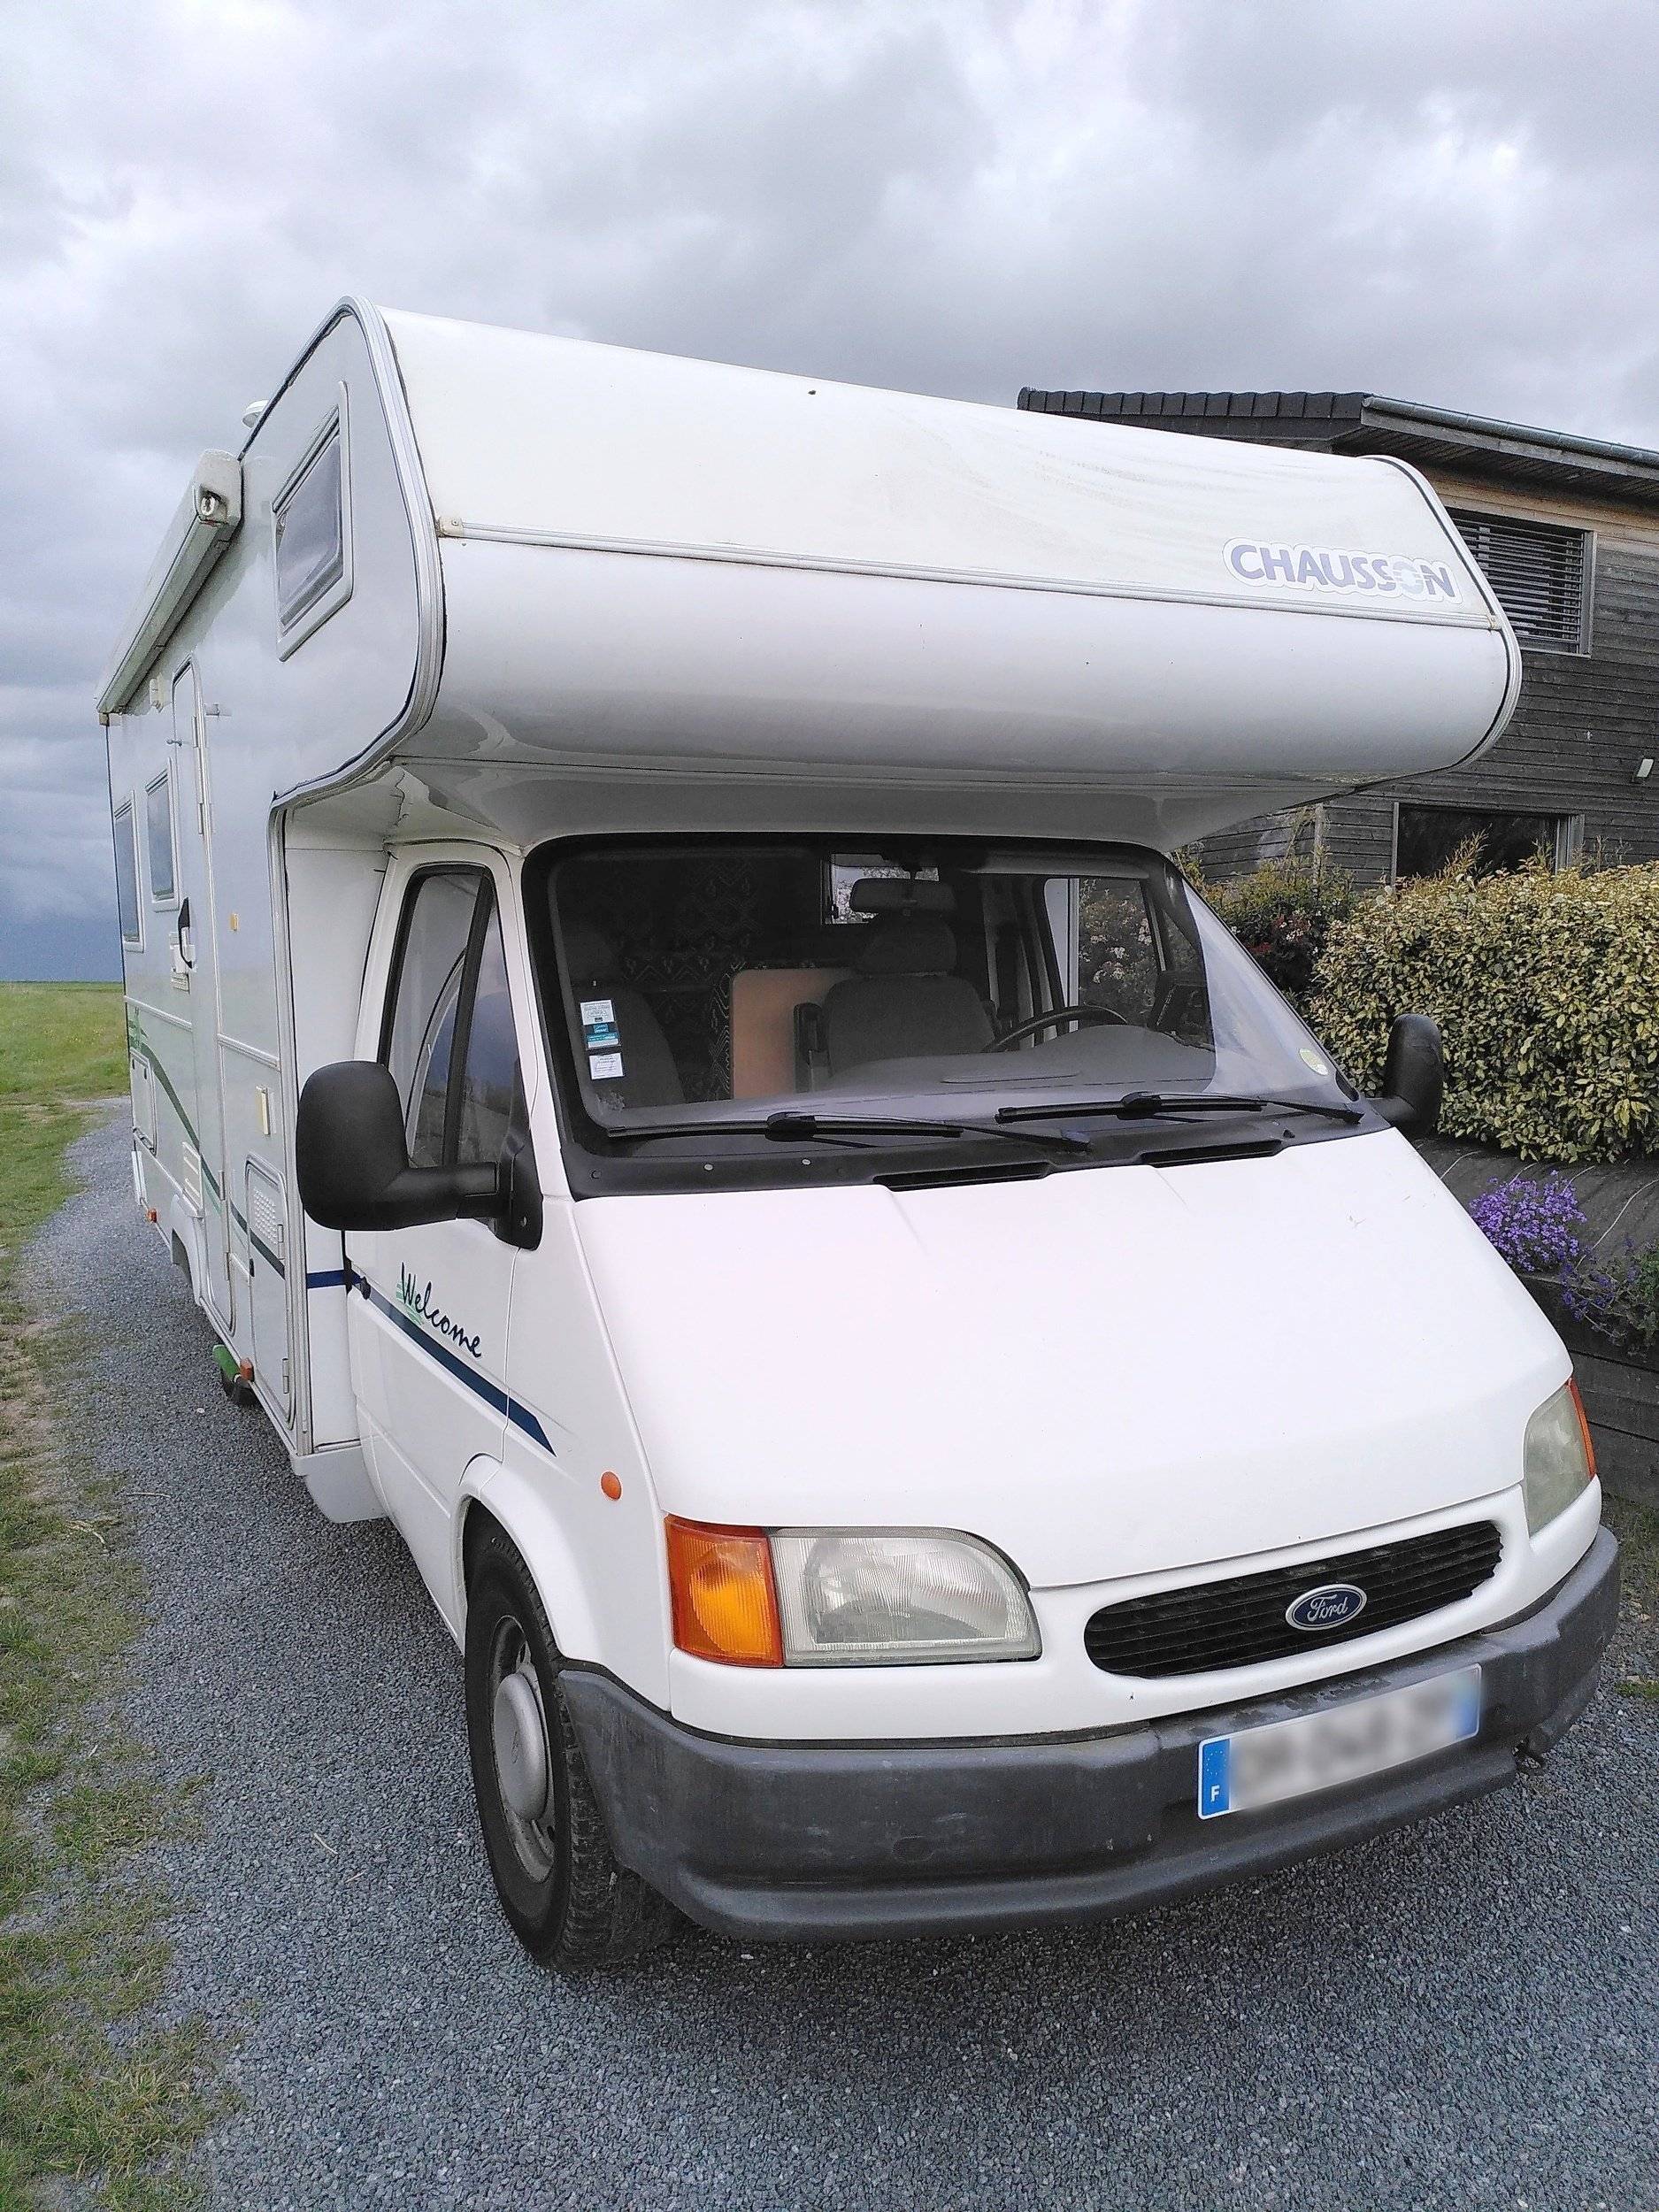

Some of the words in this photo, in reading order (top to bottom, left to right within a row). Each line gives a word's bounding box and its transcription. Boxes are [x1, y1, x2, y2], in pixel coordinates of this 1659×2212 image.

[1230, 543, 1456, 598] CHAUSSON
[401, 1261, 482, 1358] Welcome
[1307, 1594, 1348, 1622] Ford
[1210, 1784, 1220, 1802] F
